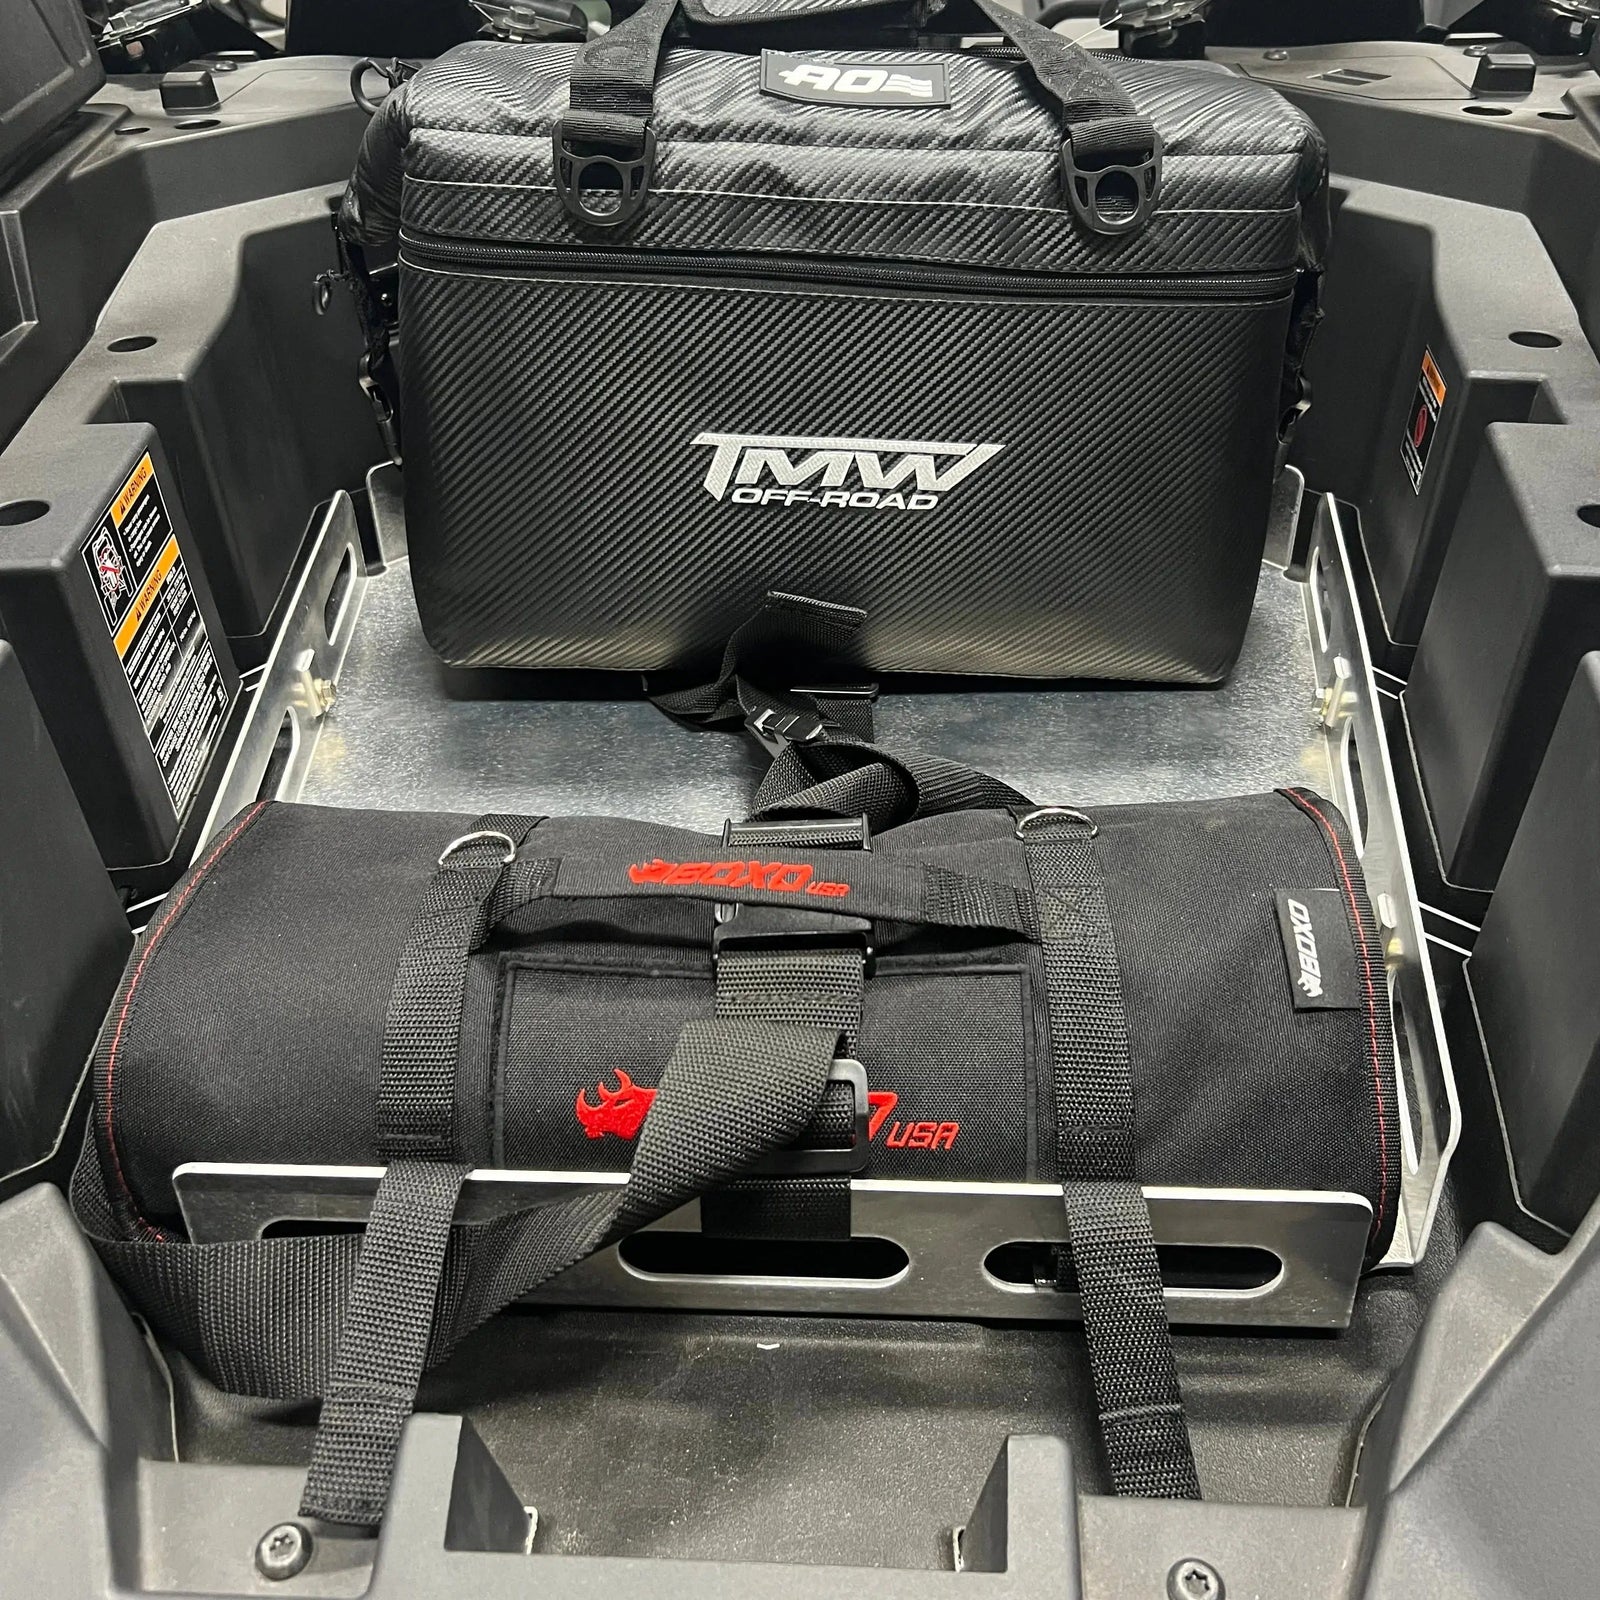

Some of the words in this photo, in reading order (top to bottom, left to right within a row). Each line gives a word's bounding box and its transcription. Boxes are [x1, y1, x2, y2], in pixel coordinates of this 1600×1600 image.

[690, 432, 1006, 502] TMW
[731, 487, 939, 510] OFF-ROAD
[663, 860, 814, 892] BOXO
[1287, 898, 1322, 979] BOXO
[886, 1121, 960, 1150] USA
